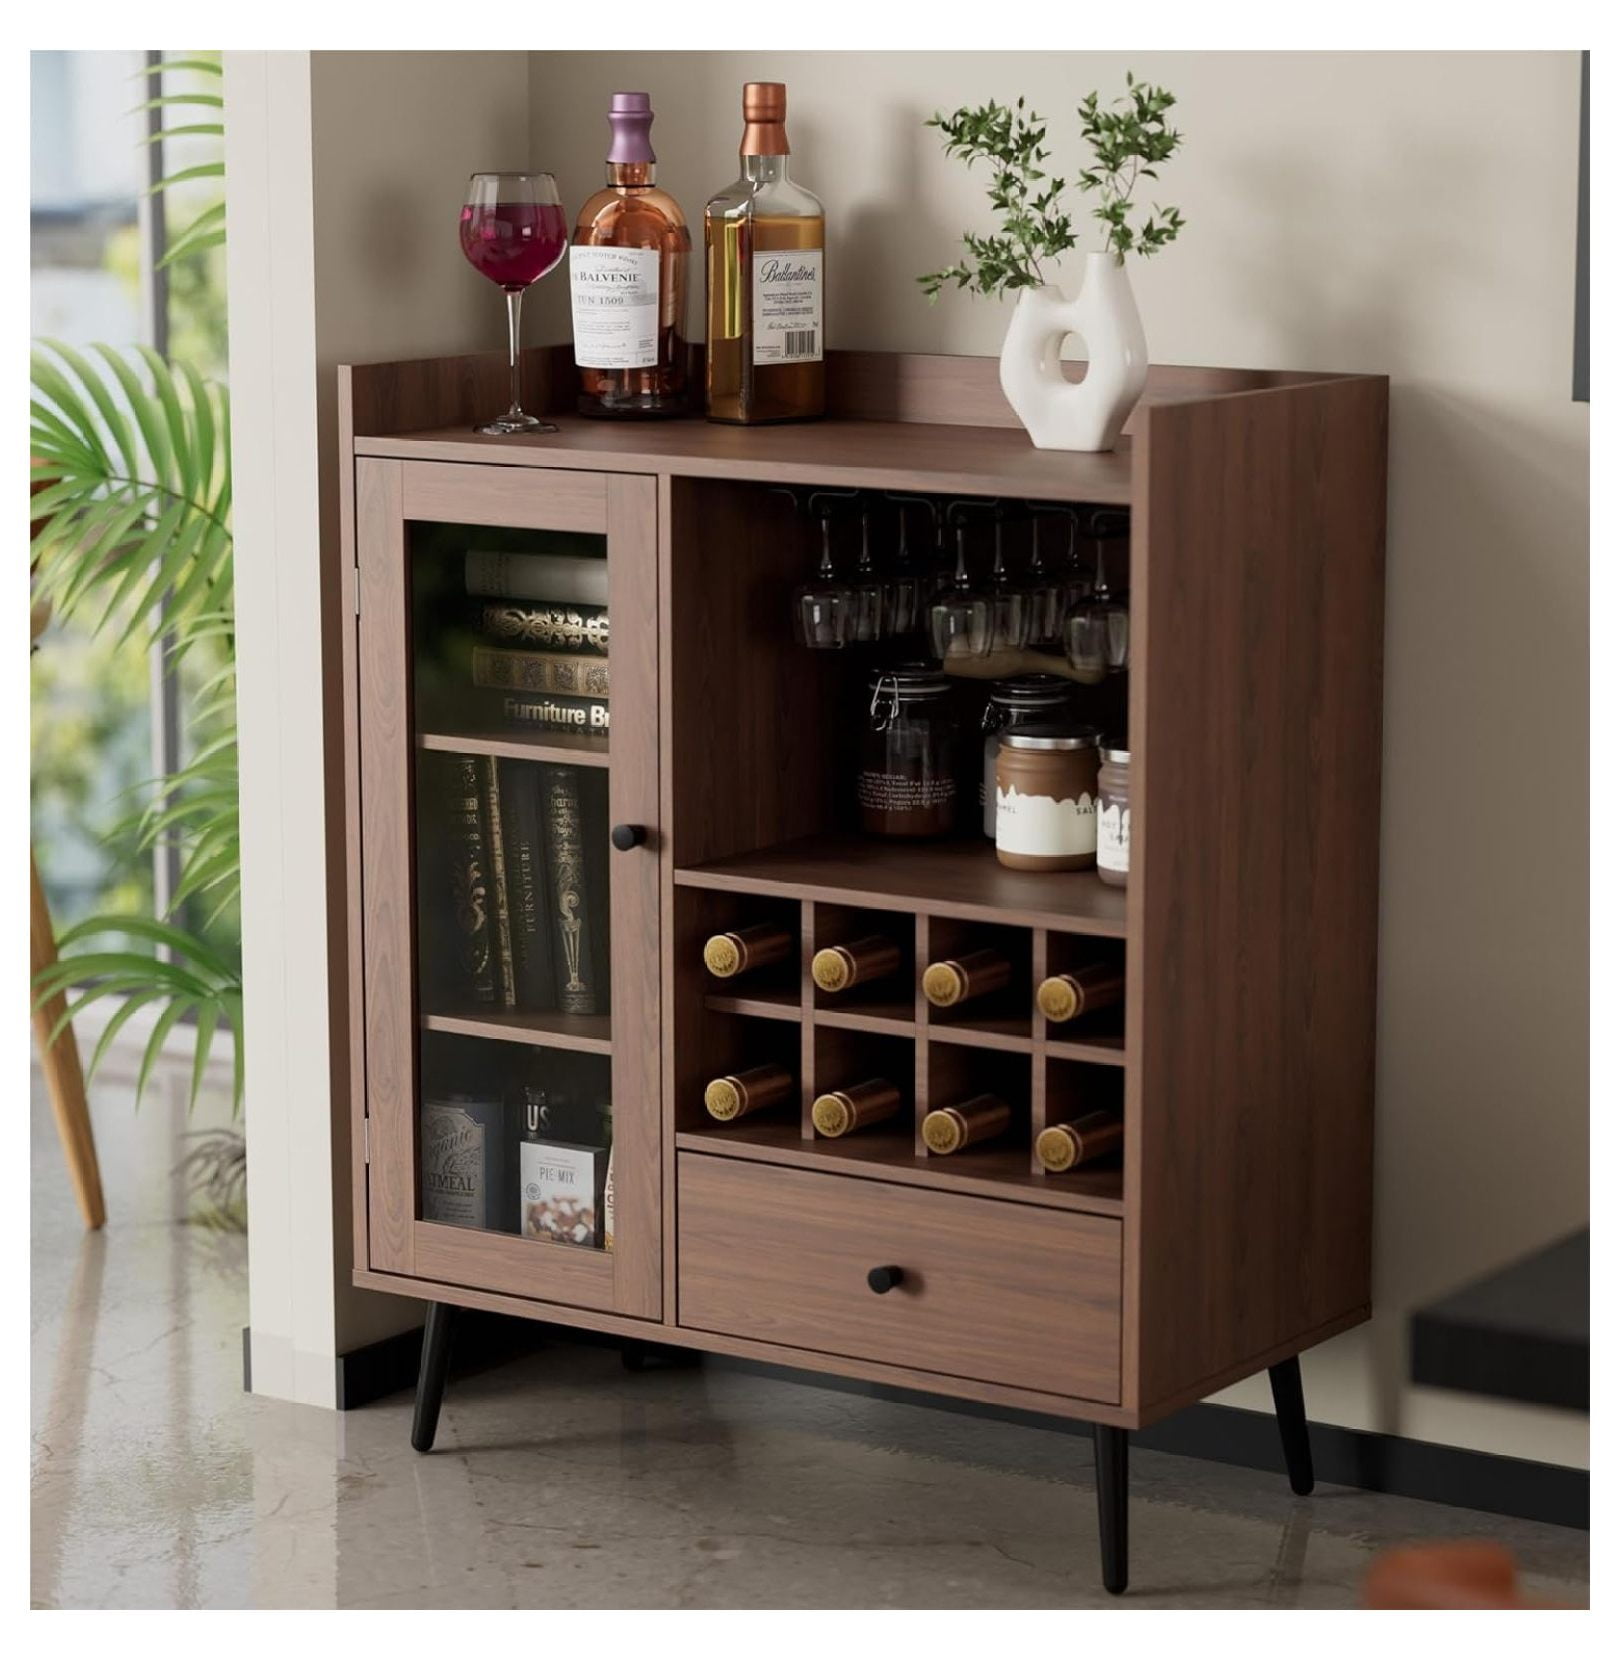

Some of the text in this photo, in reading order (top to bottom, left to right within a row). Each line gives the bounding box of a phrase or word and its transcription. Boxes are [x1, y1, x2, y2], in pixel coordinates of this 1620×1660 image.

[580, 271, 641, 282] BALVENIE
[760, 259, 817, 283] Ballantine's
[599, 296, 624, 305] 1509
[504, 697, 586, 725] Furniture
[519, 840, 536, 933] FURNITURE
[539, 1166, 576, 1184] PIE MIX
